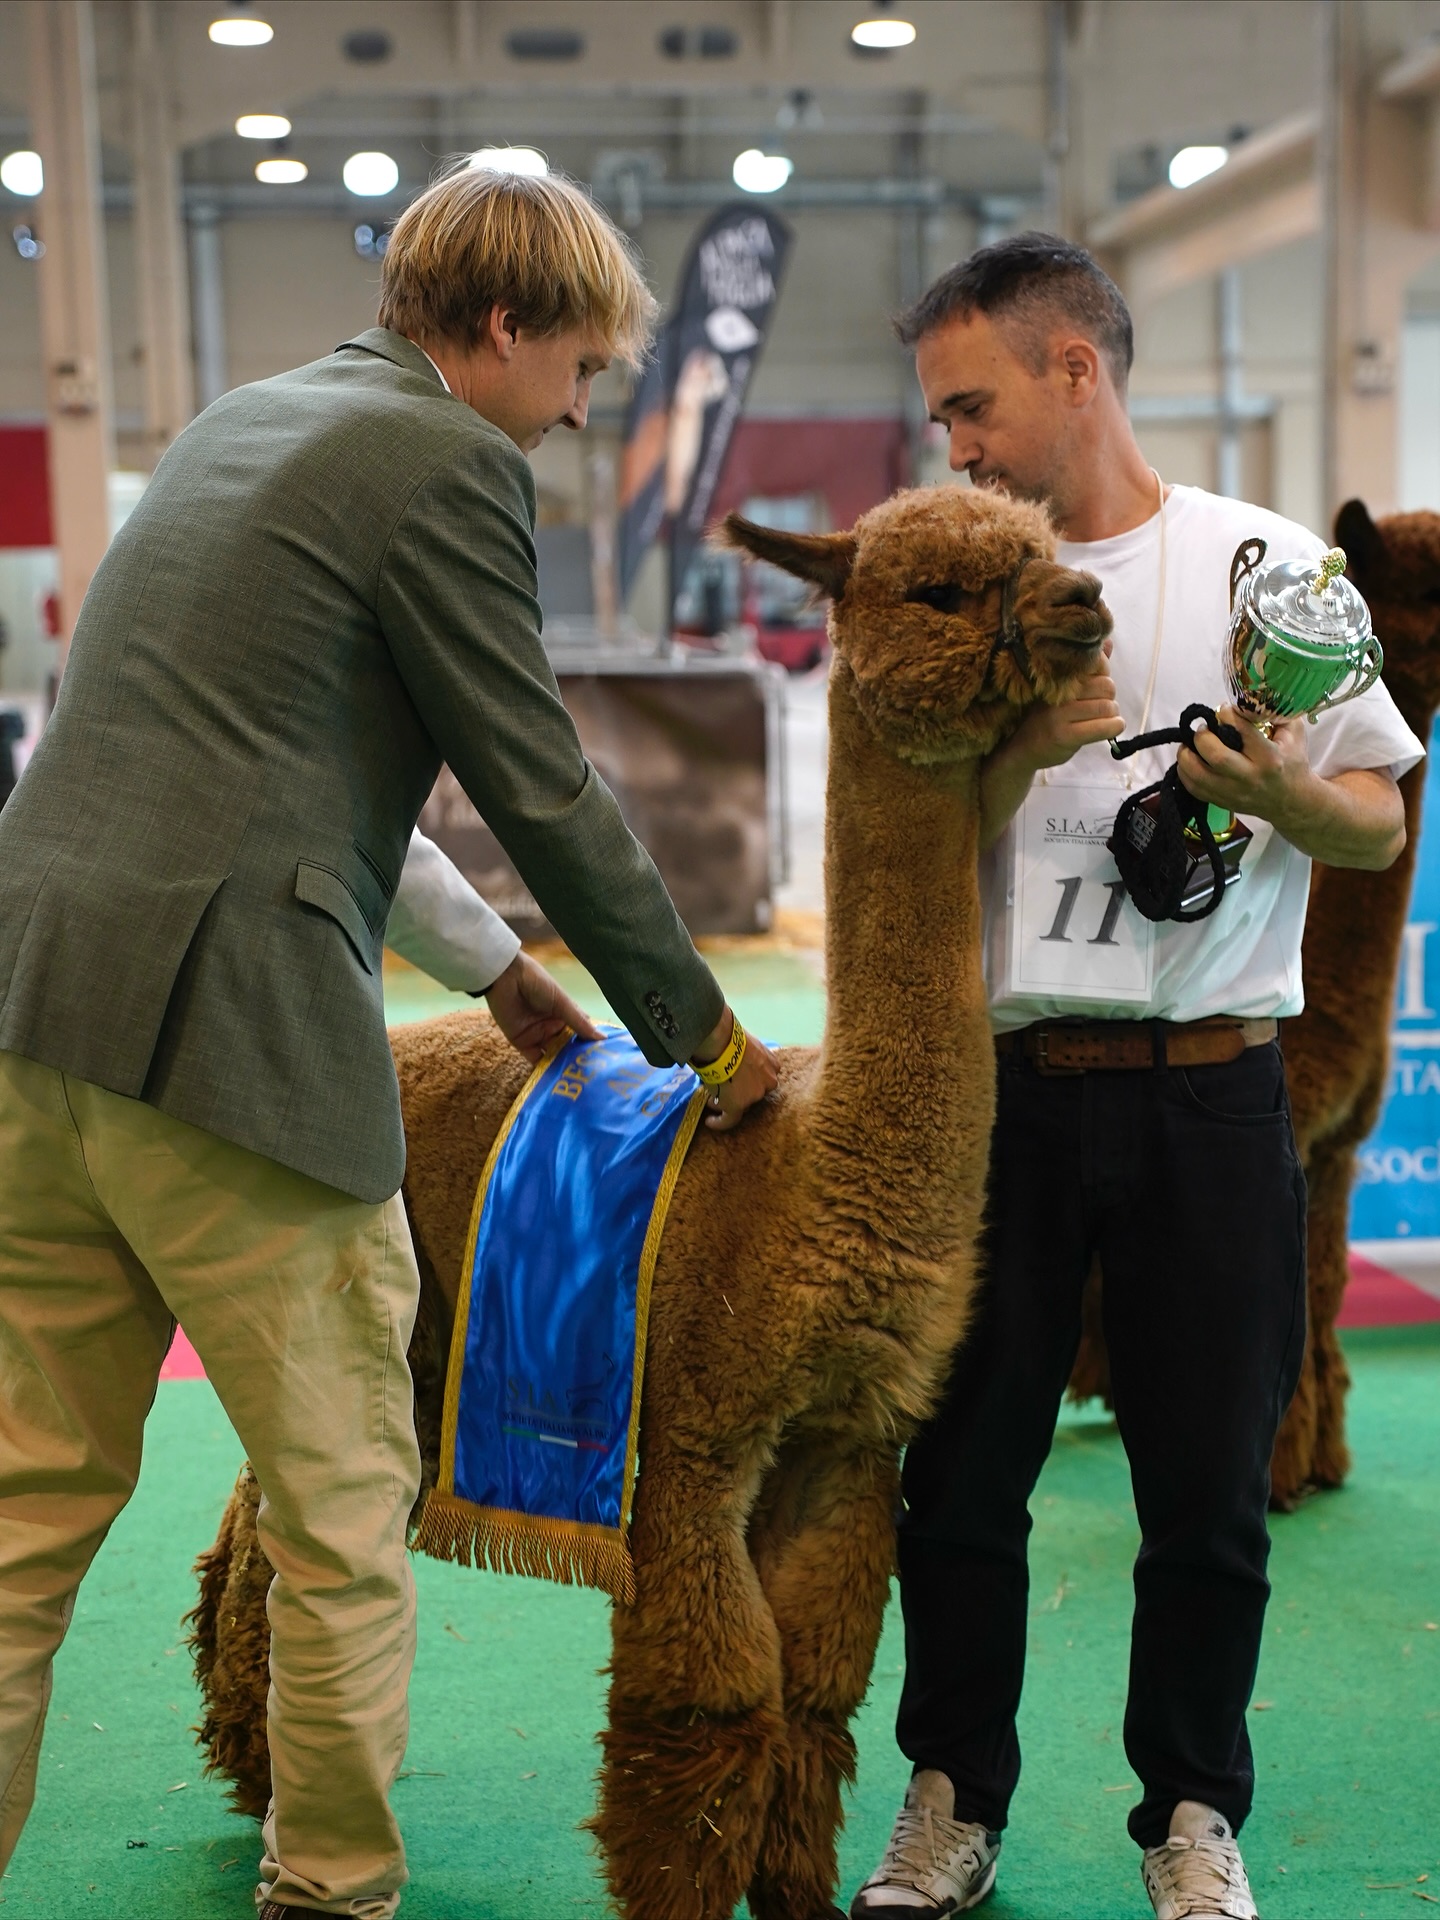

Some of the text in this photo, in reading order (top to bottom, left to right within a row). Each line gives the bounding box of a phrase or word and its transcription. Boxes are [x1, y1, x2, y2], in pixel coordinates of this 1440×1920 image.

[1046, 817, 1093, 835] S.I.A.
[1039, 876, 1125, 947] 11
[552, 1044, 619, 1101] BEST
